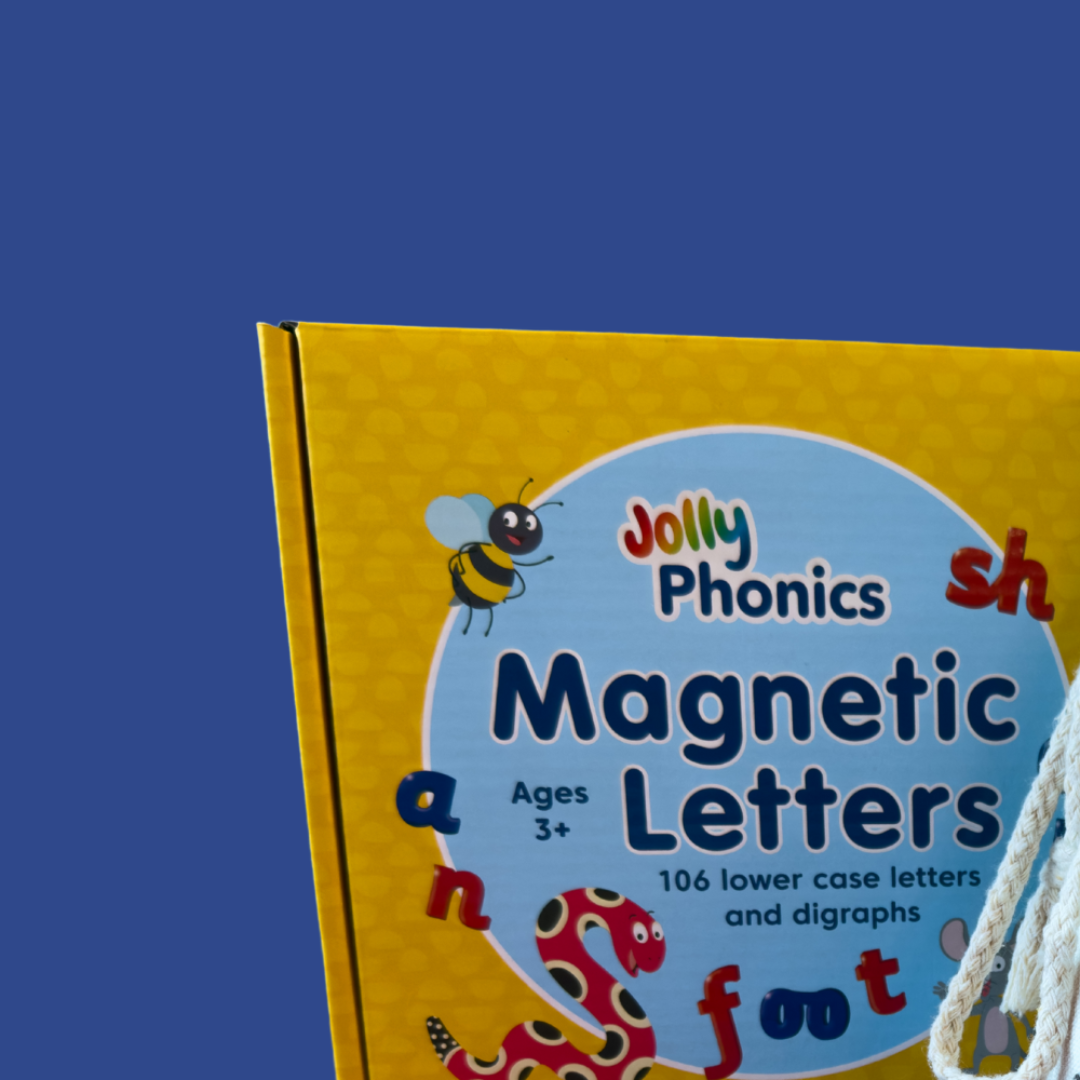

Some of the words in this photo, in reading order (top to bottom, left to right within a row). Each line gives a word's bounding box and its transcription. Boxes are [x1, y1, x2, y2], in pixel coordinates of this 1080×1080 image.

[623, 496, 752, 571] Jolly
[659, 560, 885, 619] Phonics
[493, 650, 1017, 766] Magnetic
[512, 781, 589, 811] Ages
[623, 767, 1000, 851] Letters
[535, 818, 570, 841] 3+
[660, 869, 710, 892] 106
[722, 868, 801, 891] lower
[813, 870, 880, 888] case
[891, 866, 981, 888] letters
[725, 903, 782, 926] and
[792, 900, 921, 931] digraphs
